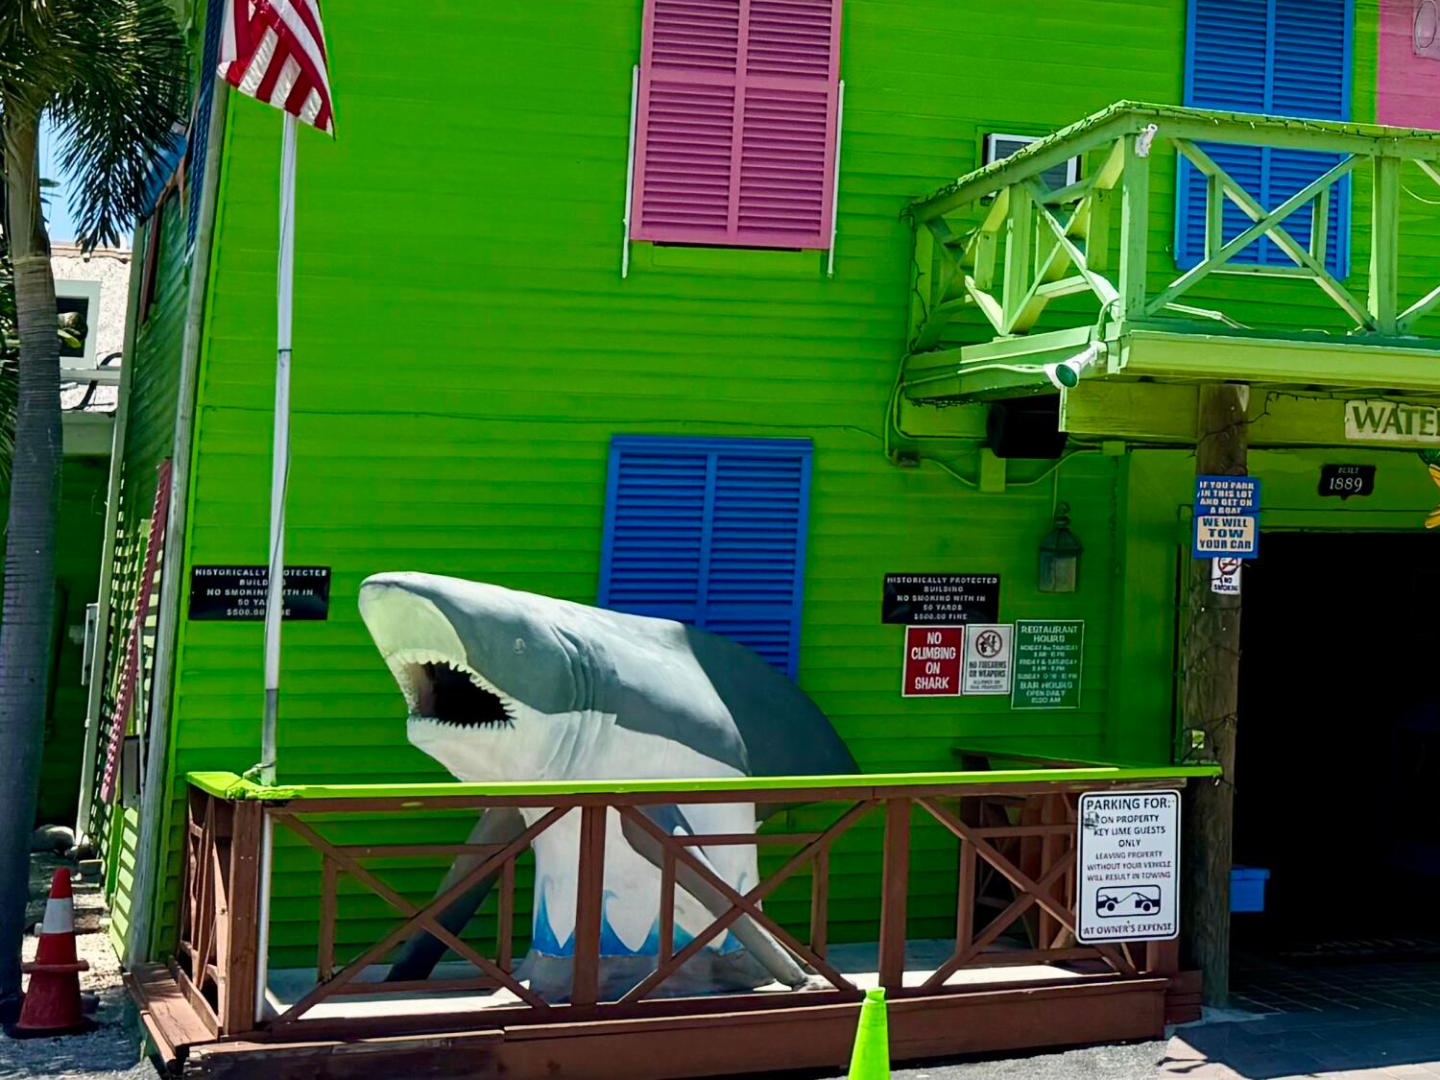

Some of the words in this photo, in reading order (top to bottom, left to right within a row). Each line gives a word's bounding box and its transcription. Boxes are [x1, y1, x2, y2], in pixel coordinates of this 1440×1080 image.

[1330, 477, 1362, 492] 1889
[1203, 518, 1219, 527] WE
[1222, 519, 1247, 527] WILL
[1208, 529, 1244, 538] TOW
[1200, 540, 1228, 549] YOUR
[1230, 540, 1251, 549] CAR
[927, 632, 941, 644] NO
[911, 647, 956, 659] CLIMBING
[925, 662, 940, 674] ON
[915, 677, 949, 689] SHARK
[1087, 798, 1140, 810] PARKING
[1144, 798, 1171, 808] FOR:
[1100, 816, 1114, 824] ON
[1116, 815, 1159, 823] PROPERTY
[1094, 828, 1109, 836] KEY
[1134, 826, 1166, 834] GUESTS
[1096, 852, 1126, 860] LEAVING
[1128, 851, 1163, 859] PROPERTY
[1087, 863, 1120, 871] WITHOUT
[1105, 873, 1130, 881] RESULT
[1083, 927, 1094, 935] AT
[1097, 925, 1135, 934] OWNER'S
[1138, 924, 1172, 932] EXPENSE
